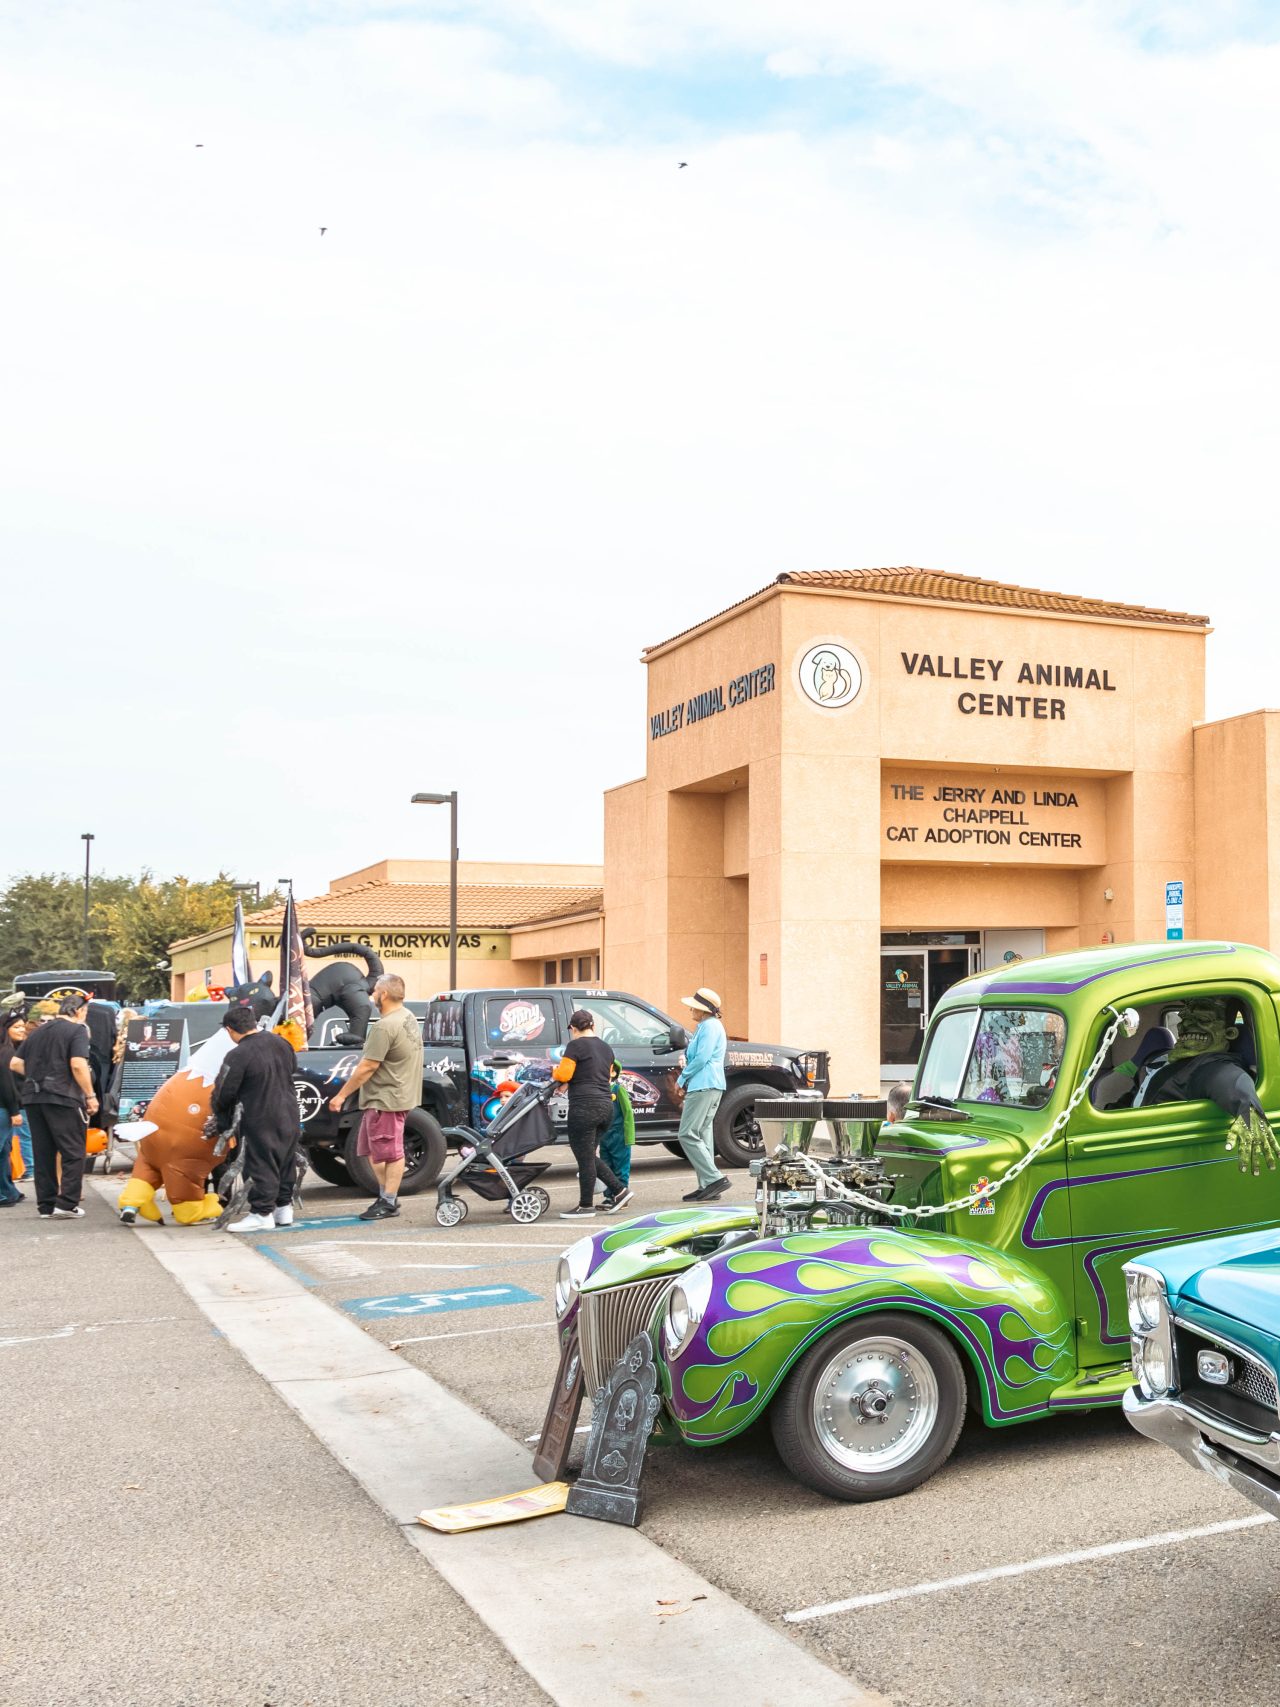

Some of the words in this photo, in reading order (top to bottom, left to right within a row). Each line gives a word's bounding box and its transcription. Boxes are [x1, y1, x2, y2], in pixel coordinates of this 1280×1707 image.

[901, 652, 1004, 682] VALLEY
[1017, 662, 1117, 692] ANIMAL
[650, 702, 685, 740] VALLEY
[686, 685, 726, 726] ANIMAL
[728, 662, 776, 708] CENTER
[957, 692, 1066, 720] CENTER
[891, 784, 925, 801] THE
[933, 786, 986, 804] JERRY
[991, 789, 1026, 805] AND
[1033, 791, 1079, 808] LINDA
[943, 807, 1030, 826] CHAPPELL
[886, 826, 919, 842] CAT
[924, 828, 1011, 846] ADOPTION
[1018, 831, 1083, 849] CENTER
[357, 934, 374, 949] G.
[379, 934, 481, 949] MORYKWAS
[384, 950, 413, 959] Clinic
